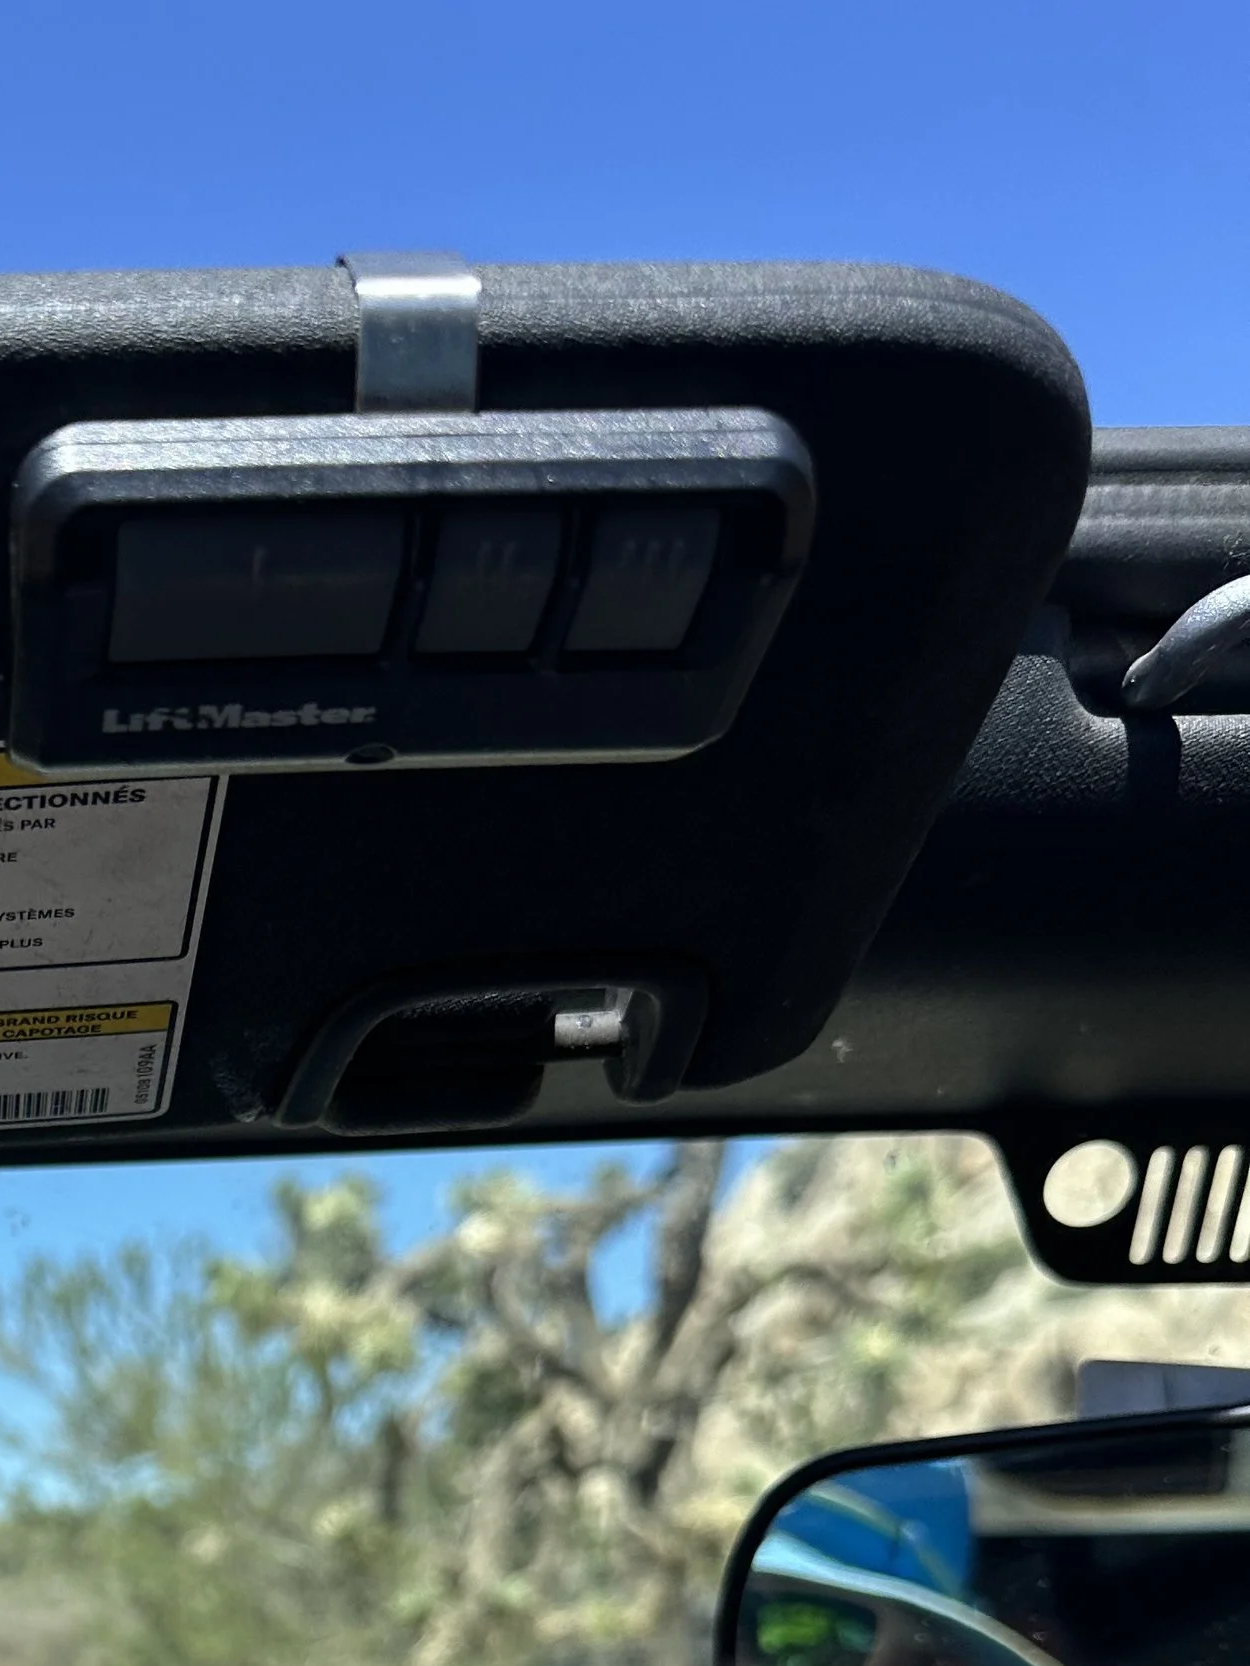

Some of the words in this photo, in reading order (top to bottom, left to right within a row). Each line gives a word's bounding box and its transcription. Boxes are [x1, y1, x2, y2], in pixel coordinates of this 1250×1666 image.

[102, 701, 377, 734] LiftMaster
[20, 819, 55, 831] PAR
[0, 937, 43, 950] PLUS
[65, 1010, 137, 1023] RISQUE
[2, 1025, 101, 1039] CAPOTAGE
